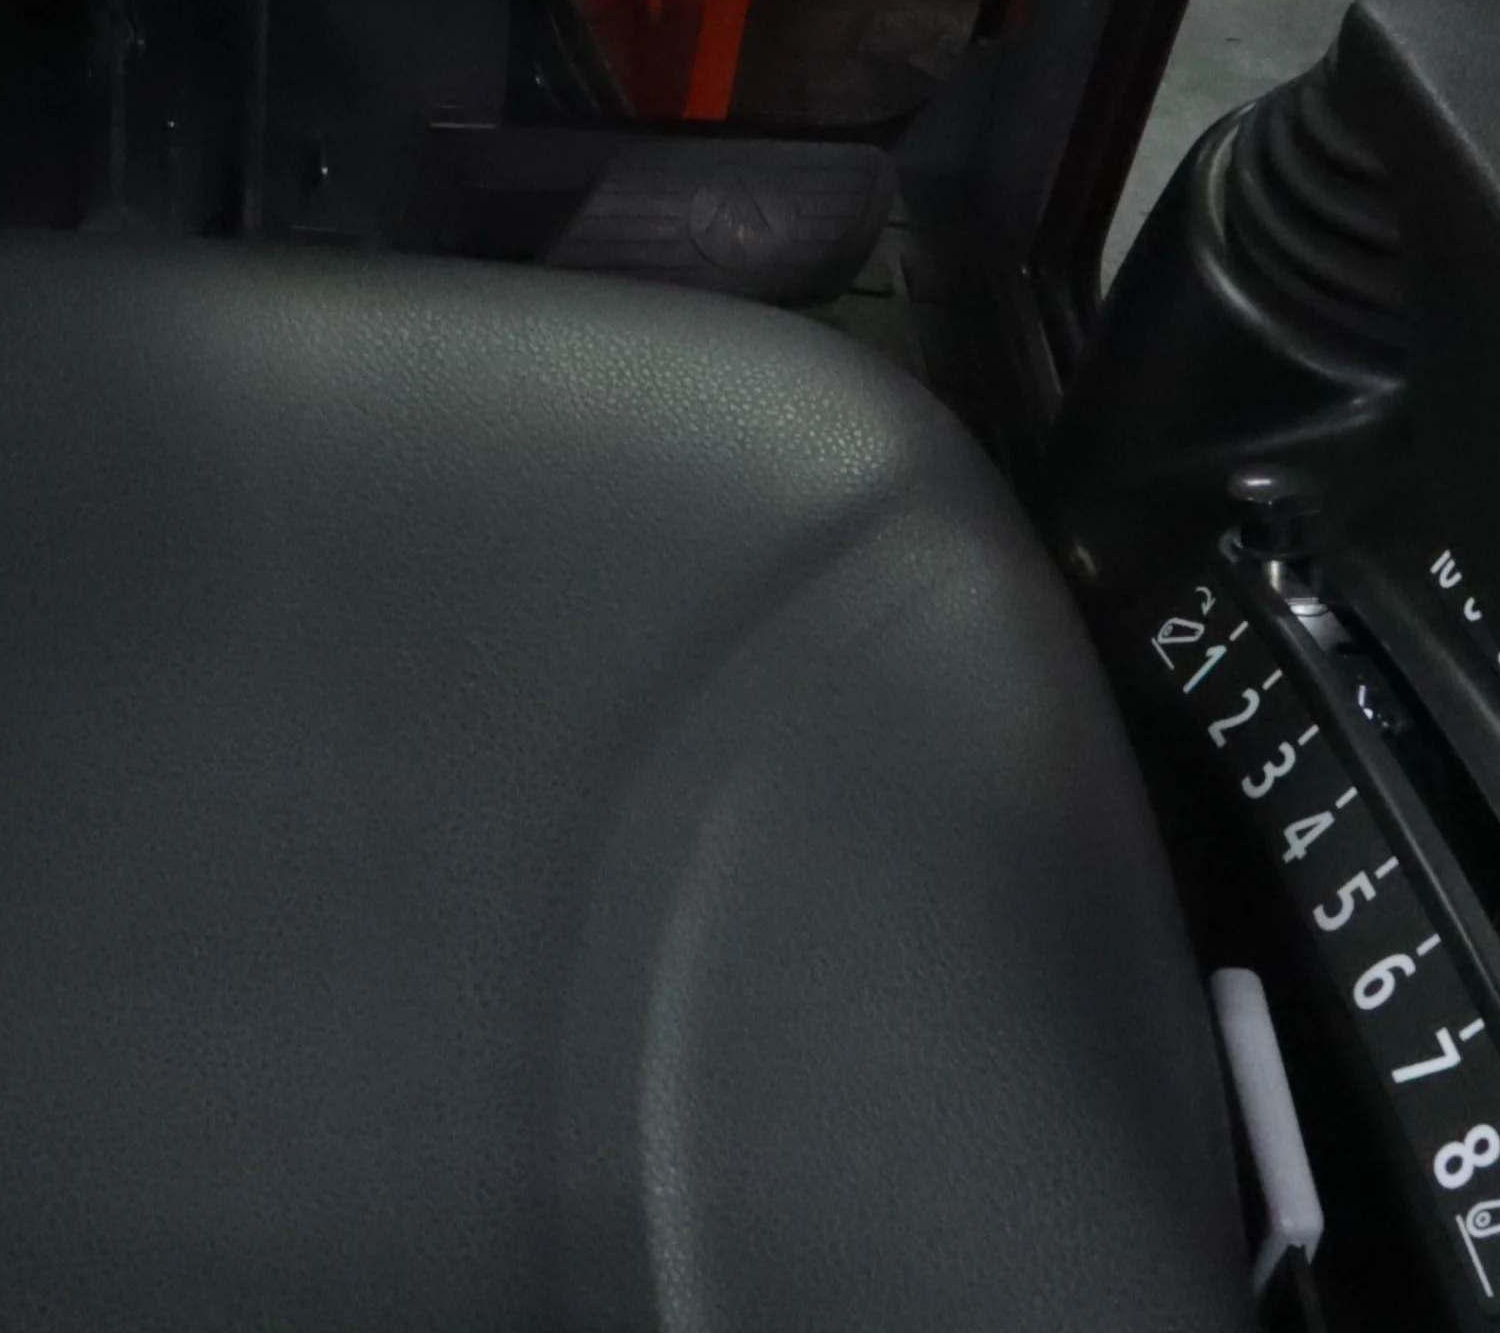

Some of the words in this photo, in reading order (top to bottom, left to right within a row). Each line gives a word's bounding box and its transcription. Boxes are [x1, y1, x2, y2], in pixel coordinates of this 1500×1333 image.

[1183, 644, 1226, 694] 1
[1208, 689, 1259, 749] 2
[1241, 741, 1297, 800] 3
[1281, 812, 1336, 865] 4
[1312, 871, 1376, 933] 5
[1352, 961, 1415, 1012] 6
[1391, 1026, 1462, 1084] 7
